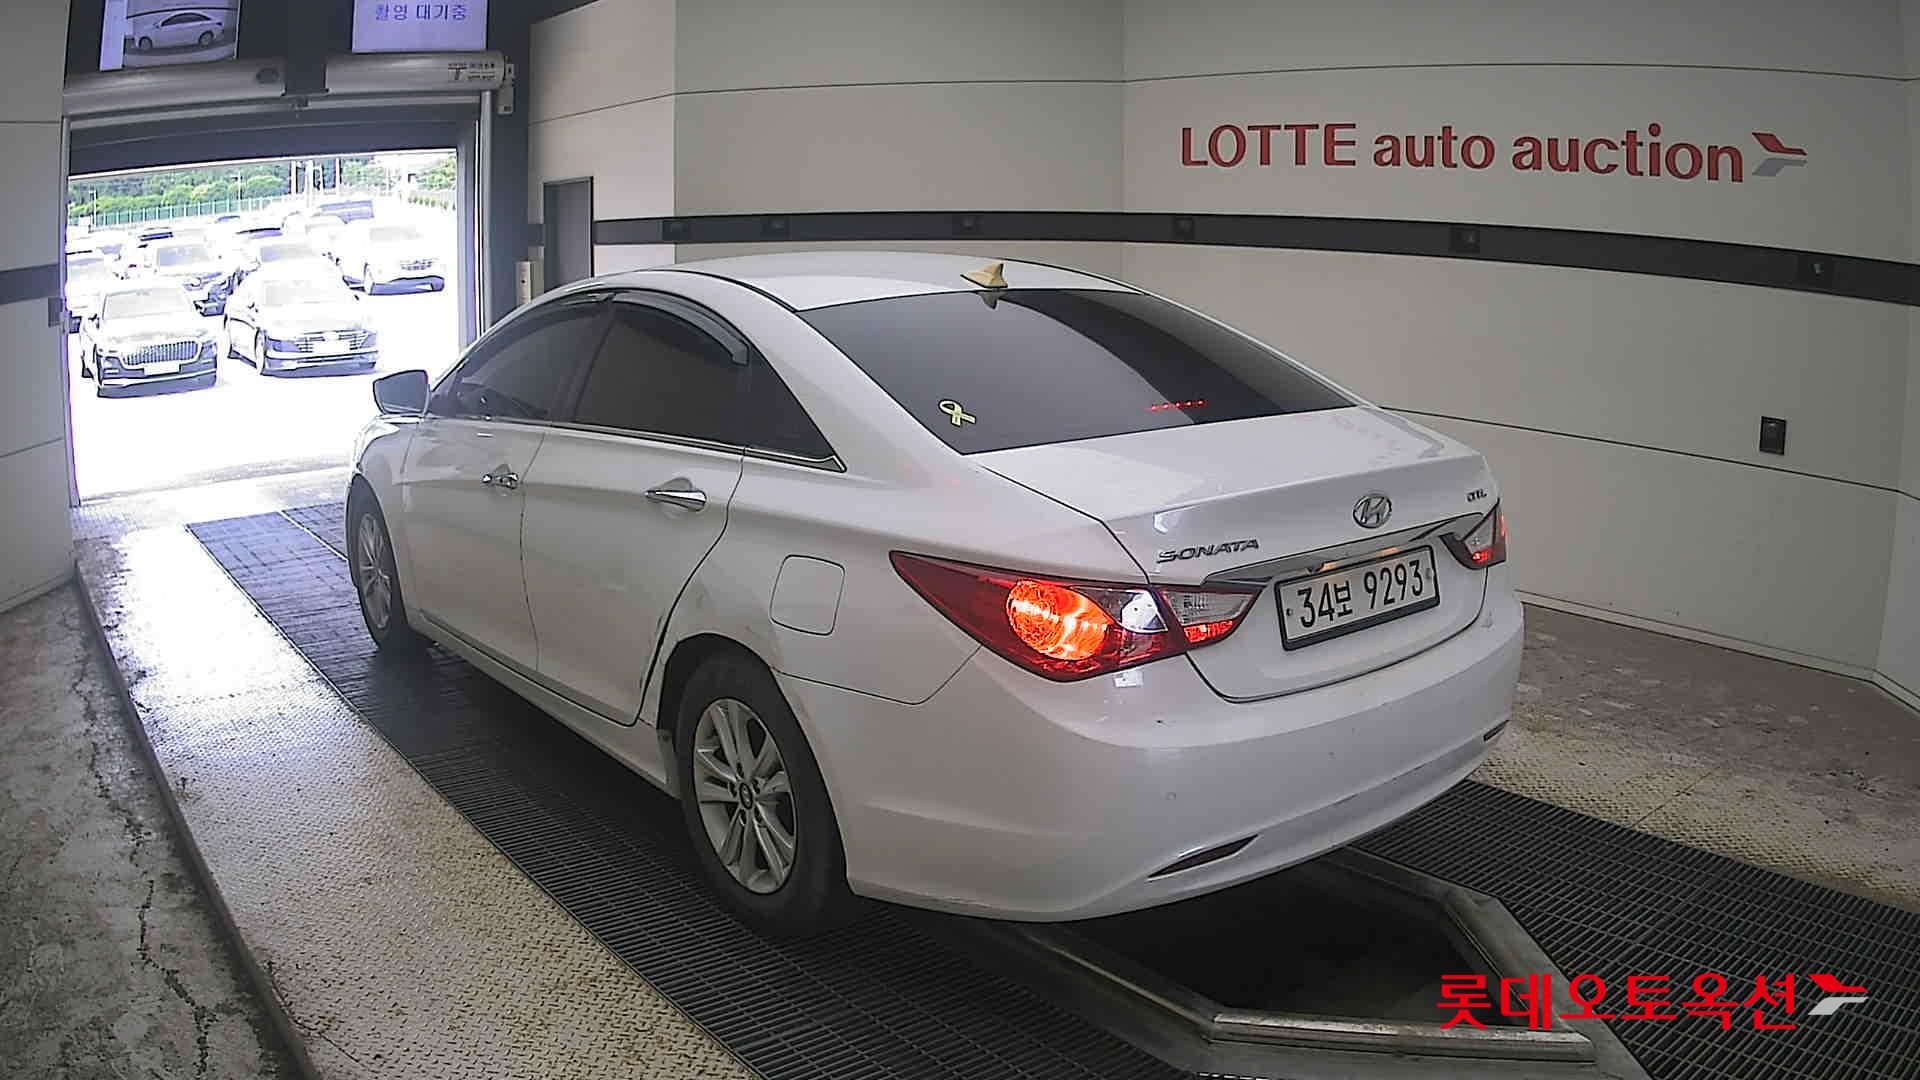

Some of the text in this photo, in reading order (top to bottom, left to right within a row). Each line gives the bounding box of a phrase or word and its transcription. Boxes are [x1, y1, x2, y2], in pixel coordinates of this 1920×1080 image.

[416, 4, 466, 20] 대기중
[1181, 122, 1744, 183] LOTTE auto auction
[1157, 539, 1259, 564] SONATA
[1297, 559, 1423, 628] 34보 9293
